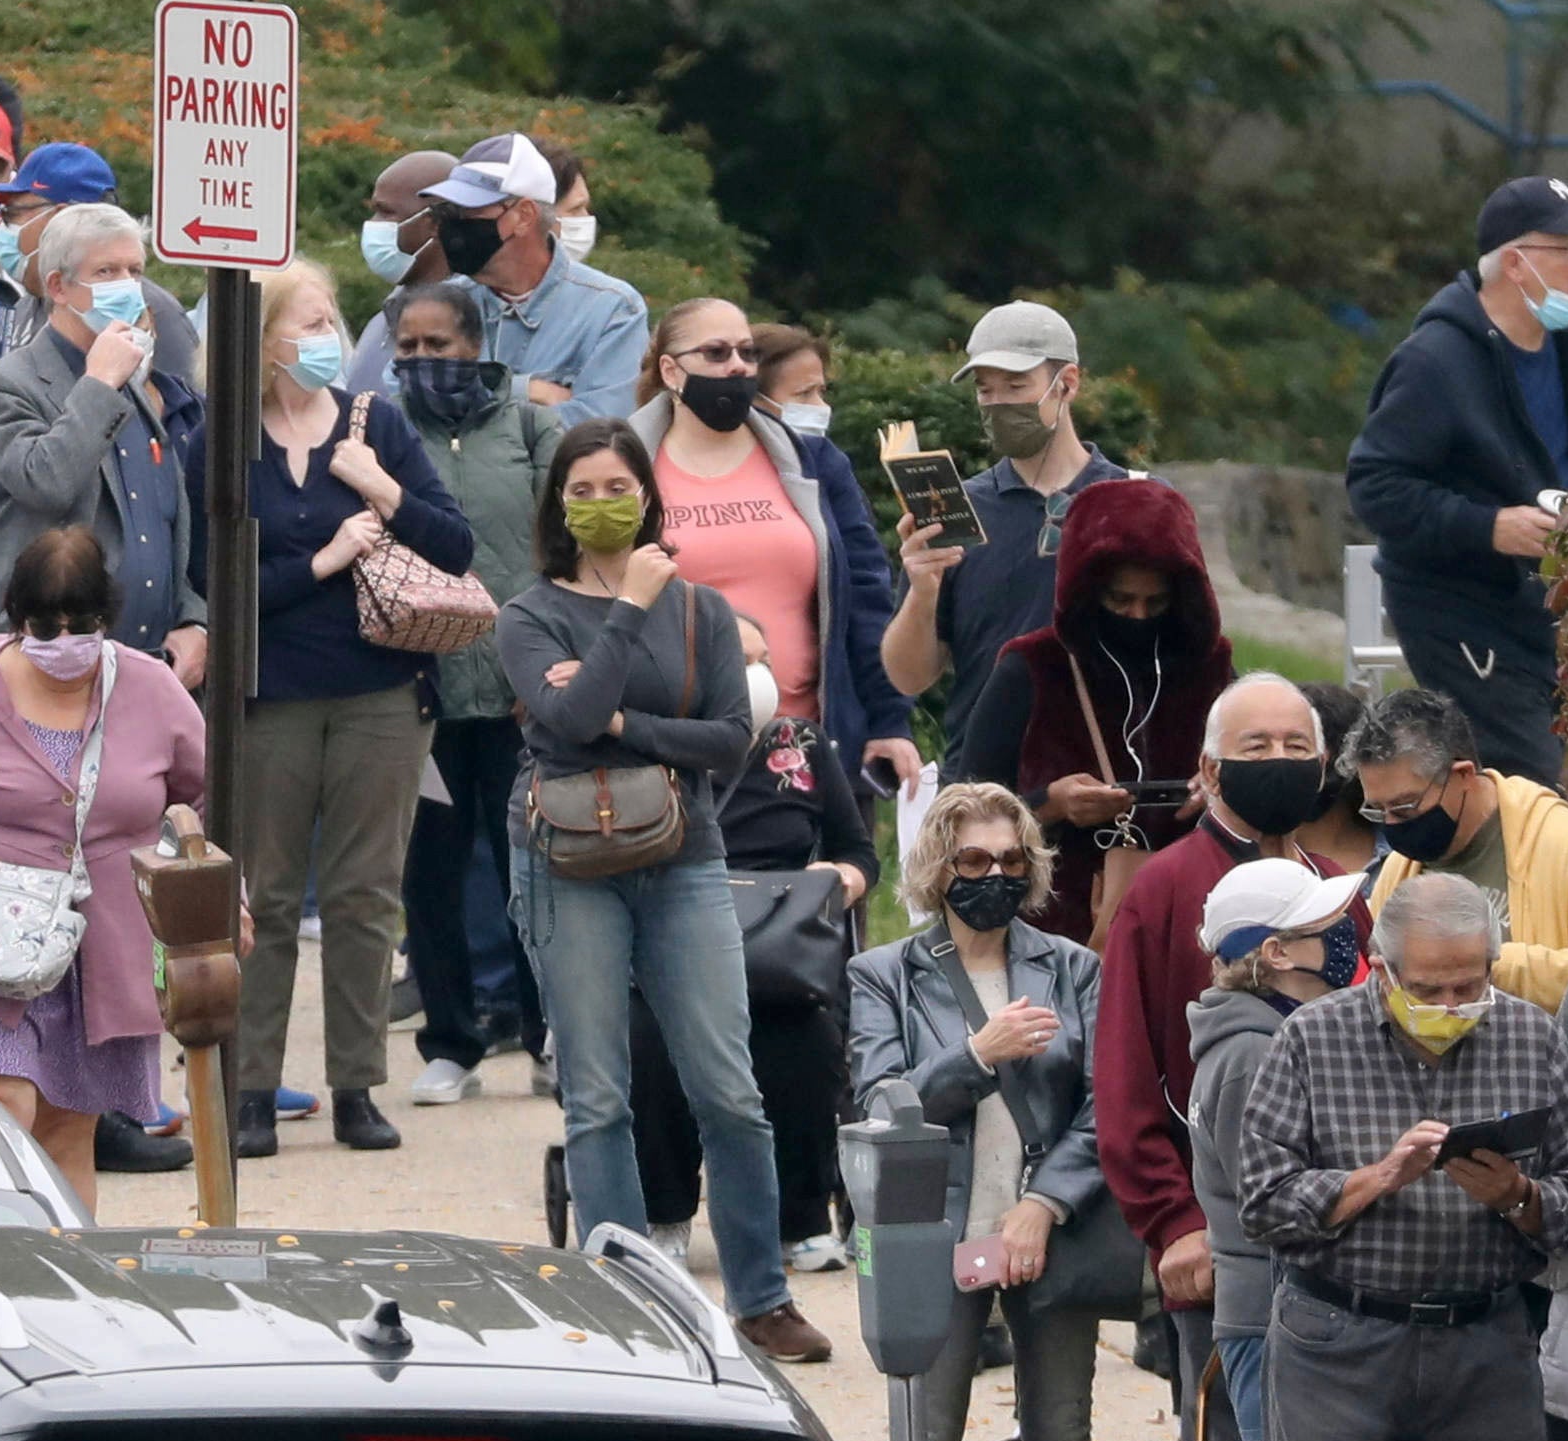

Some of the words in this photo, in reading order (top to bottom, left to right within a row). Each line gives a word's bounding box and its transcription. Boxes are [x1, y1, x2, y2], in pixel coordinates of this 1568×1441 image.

[204, 19, 253, 68] NO
[167, 75, 287, 130] PARKING
[204, 138, 249, 167] ANY
[199, 178, 253, 209] TIME
[666, 500, 783, 529] PINK
